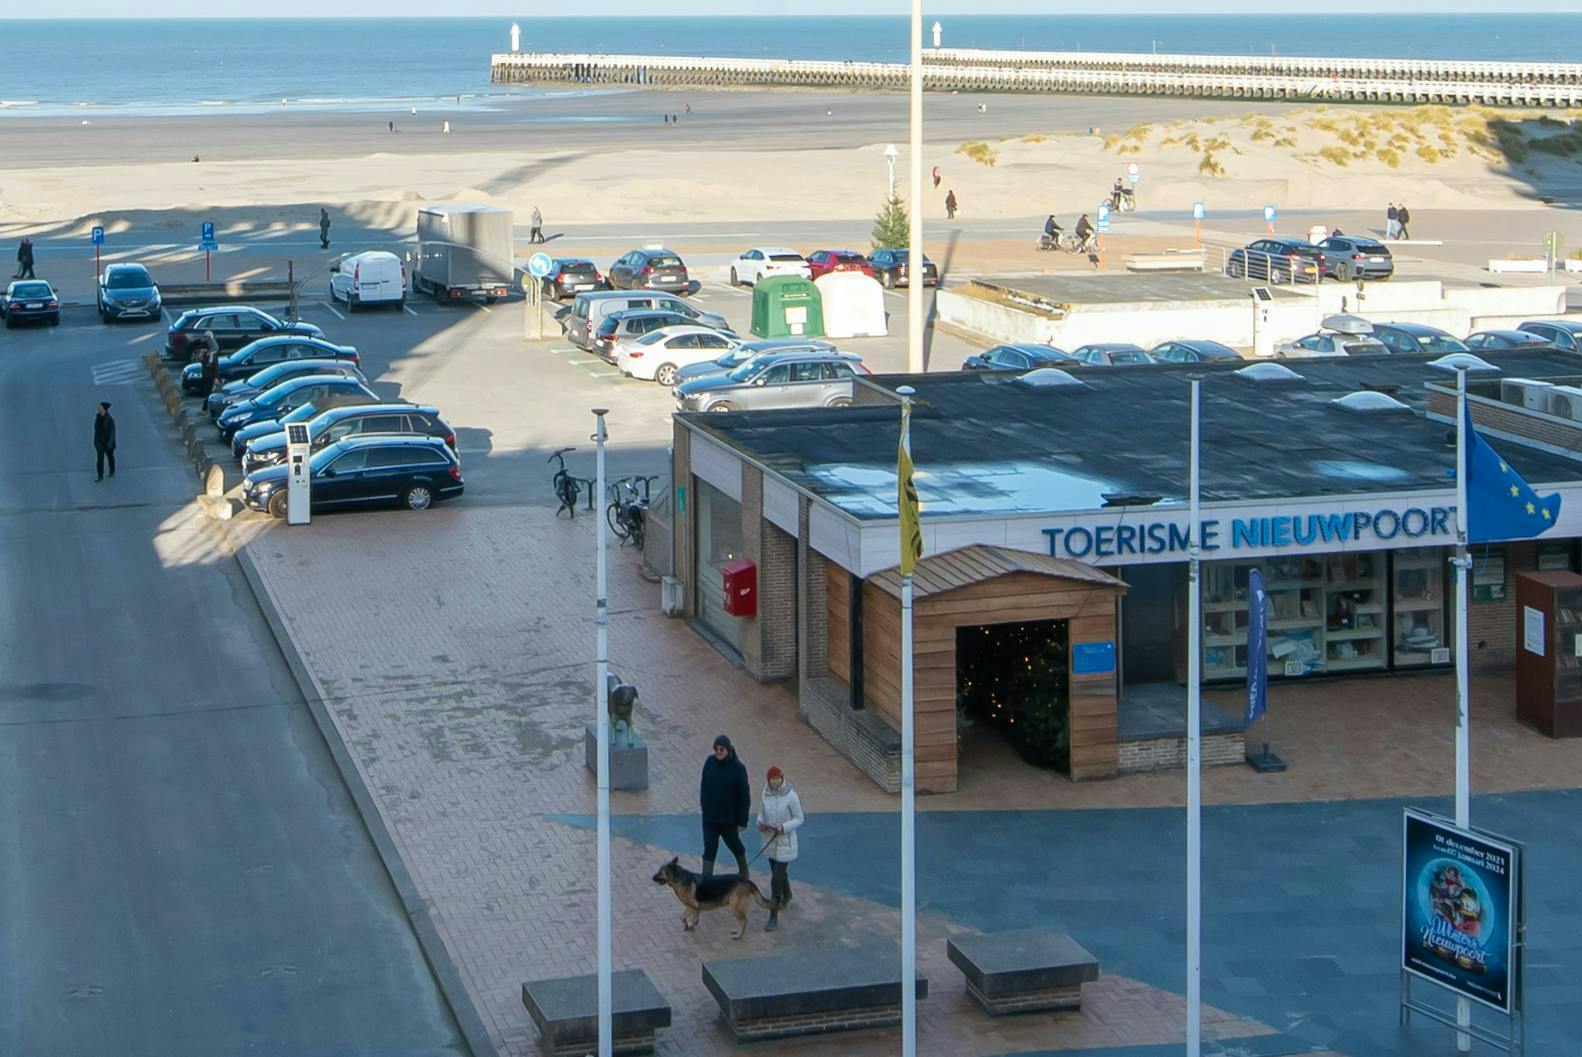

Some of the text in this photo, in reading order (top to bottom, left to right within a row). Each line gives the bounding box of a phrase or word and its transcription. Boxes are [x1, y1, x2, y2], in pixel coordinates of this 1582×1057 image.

[94, 229, 102, 240] P
[205, 223, 211, 232] P
[1041, 506, 1458, 557] TOERISME NIEUWPOOR
[1446, 838, 1485, 858] december
[1486, 861, 1505, 875] 2024
[1432, 916, 1479, 948] Winters
[1420, 924, 1492, 964] Nieuwpoort
